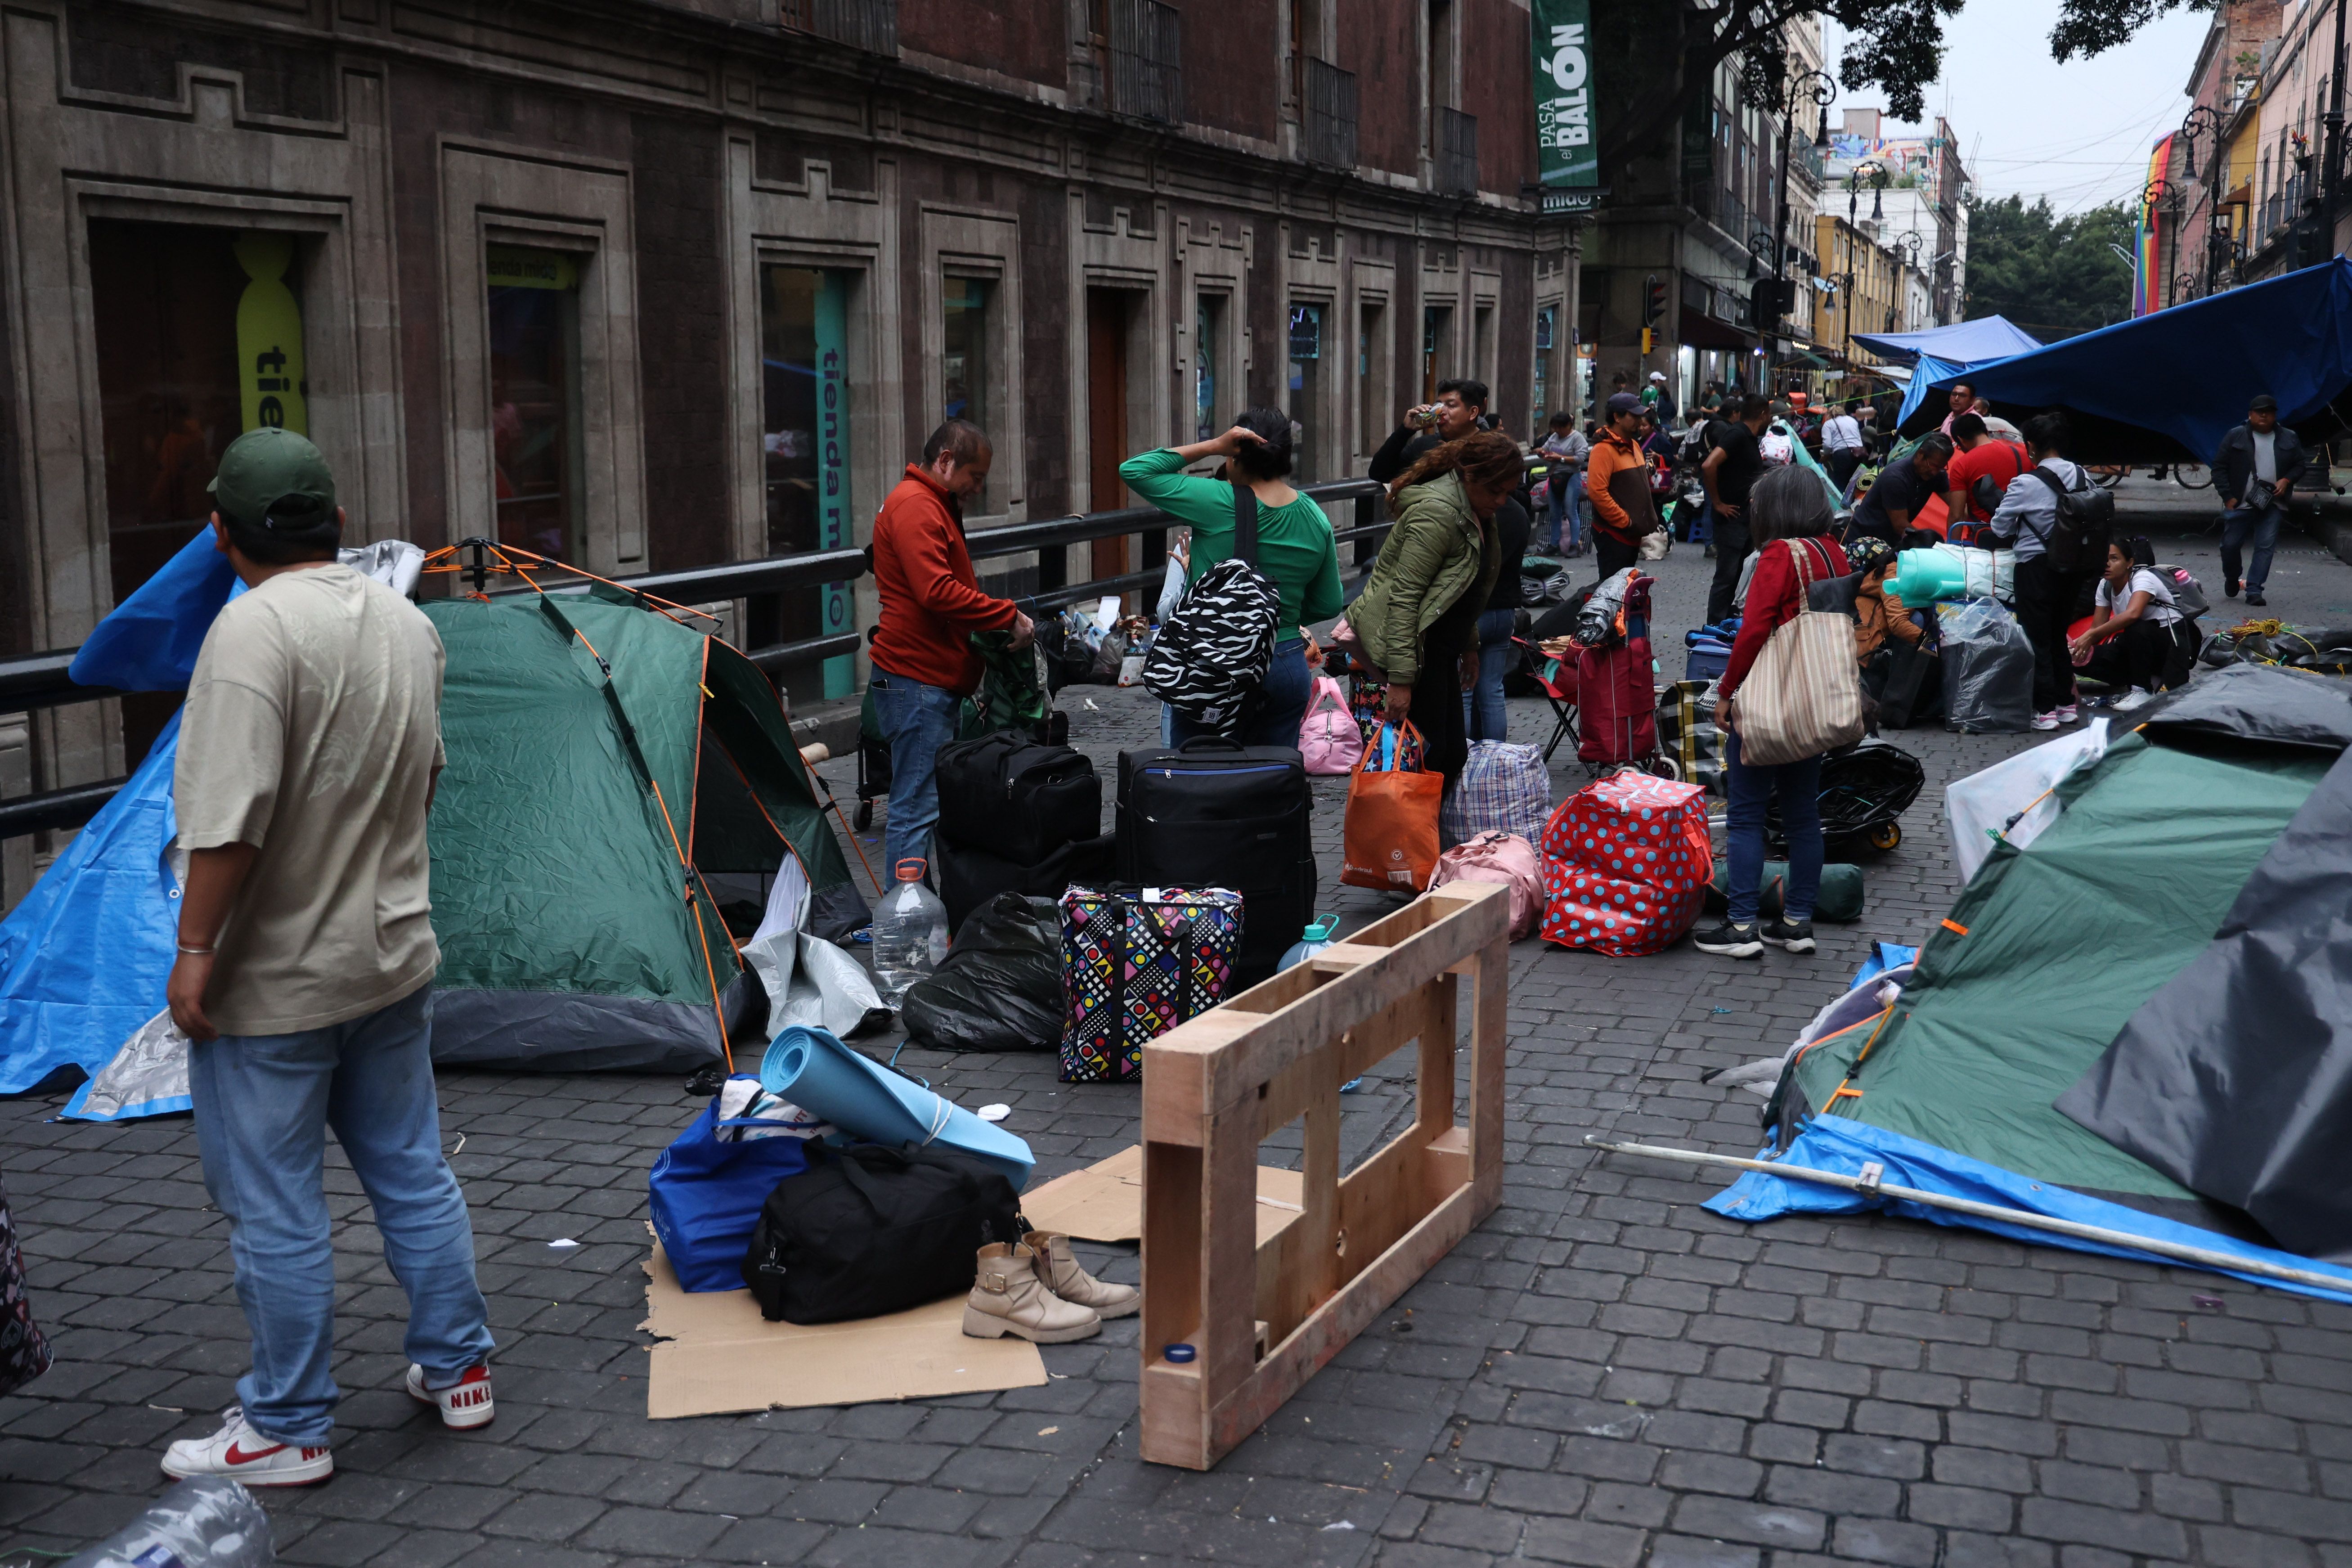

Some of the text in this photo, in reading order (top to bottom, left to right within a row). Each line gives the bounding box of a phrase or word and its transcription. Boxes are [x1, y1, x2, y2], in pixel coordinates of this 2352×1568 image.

[1539, 98, 1556, 148] PASA
[1540, 23, 1589, 160] el BALÓN
[257, 346, 290, 428] tie
[824, 348, 841, 496] tienda
[451, 1387, 490, 1408] NIKE
[301, 1447, 328, 1462] NI
